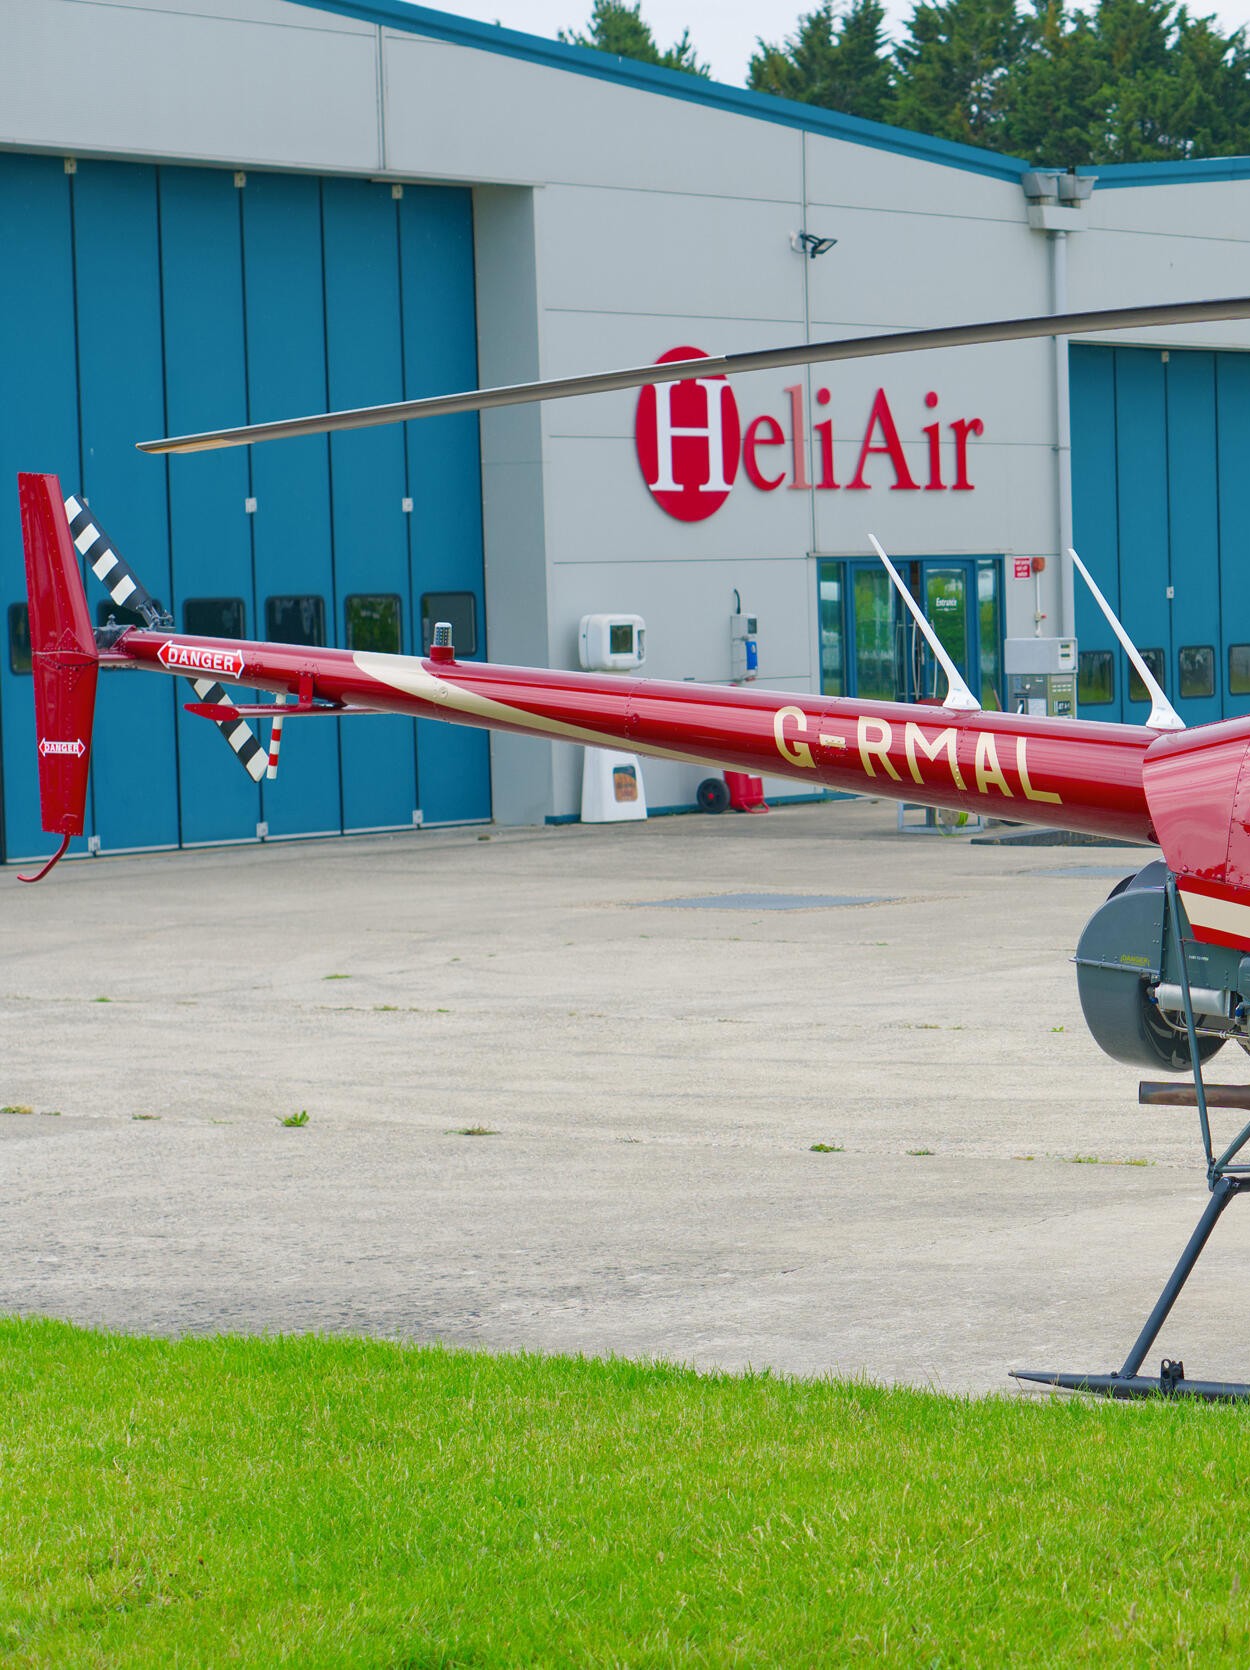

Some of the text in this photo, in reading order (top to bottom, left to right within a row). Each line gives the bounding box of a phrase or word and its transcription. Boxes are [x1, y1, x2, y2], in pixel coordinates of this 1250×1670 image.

[649, 377, 984, 491] HeliAir
[167, 647, 234, 671] DANGER
[45, 743, 79, 752] DANGER
[773, 705, 1063, 805] G-RMAL
